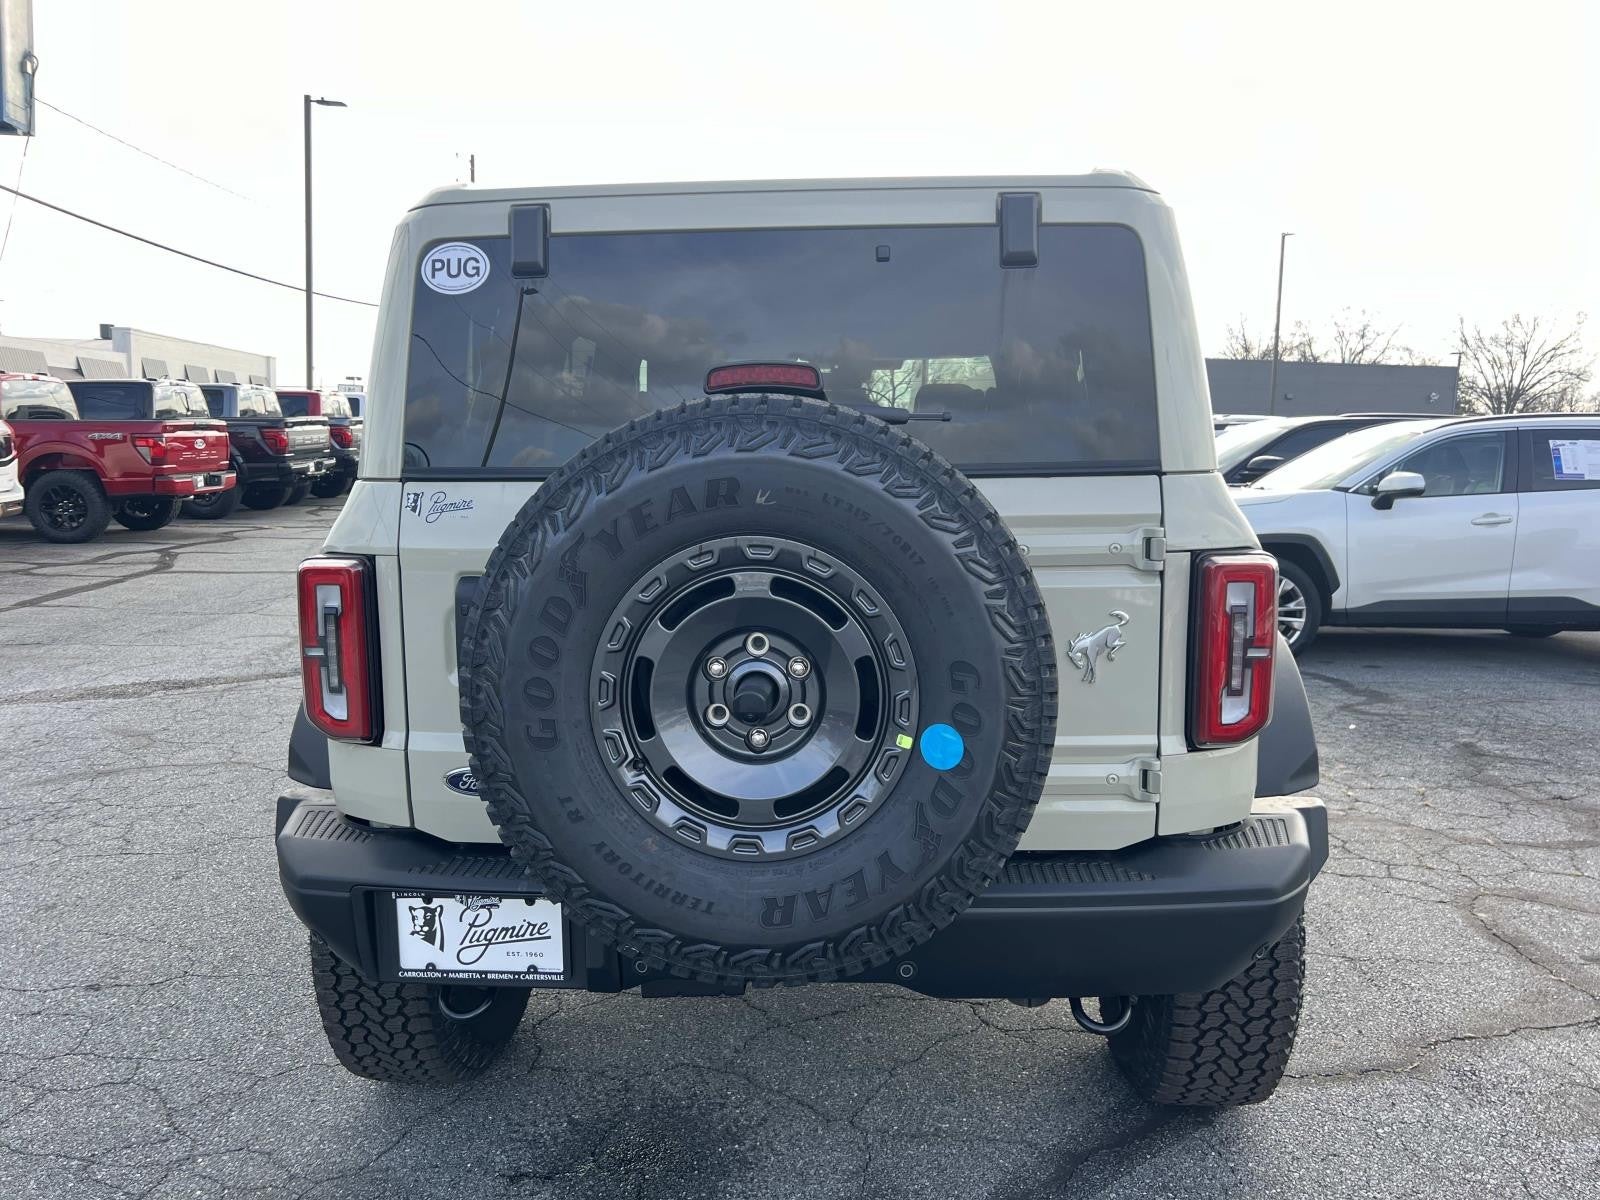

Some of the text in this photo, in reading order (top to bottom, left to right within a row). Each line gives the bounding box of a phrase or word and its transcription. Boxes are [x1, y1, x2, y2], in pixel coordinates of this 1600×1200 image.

[430, 256, 481, 280] PUG
[425, 491, 474, 524] Pugmire
[459, 773, 478, 790] Fo
[557, 795, 584, 823] RT
[592, 840, 717, 914] TERRITORY
[456, 908, 552, 966] Pugmire
